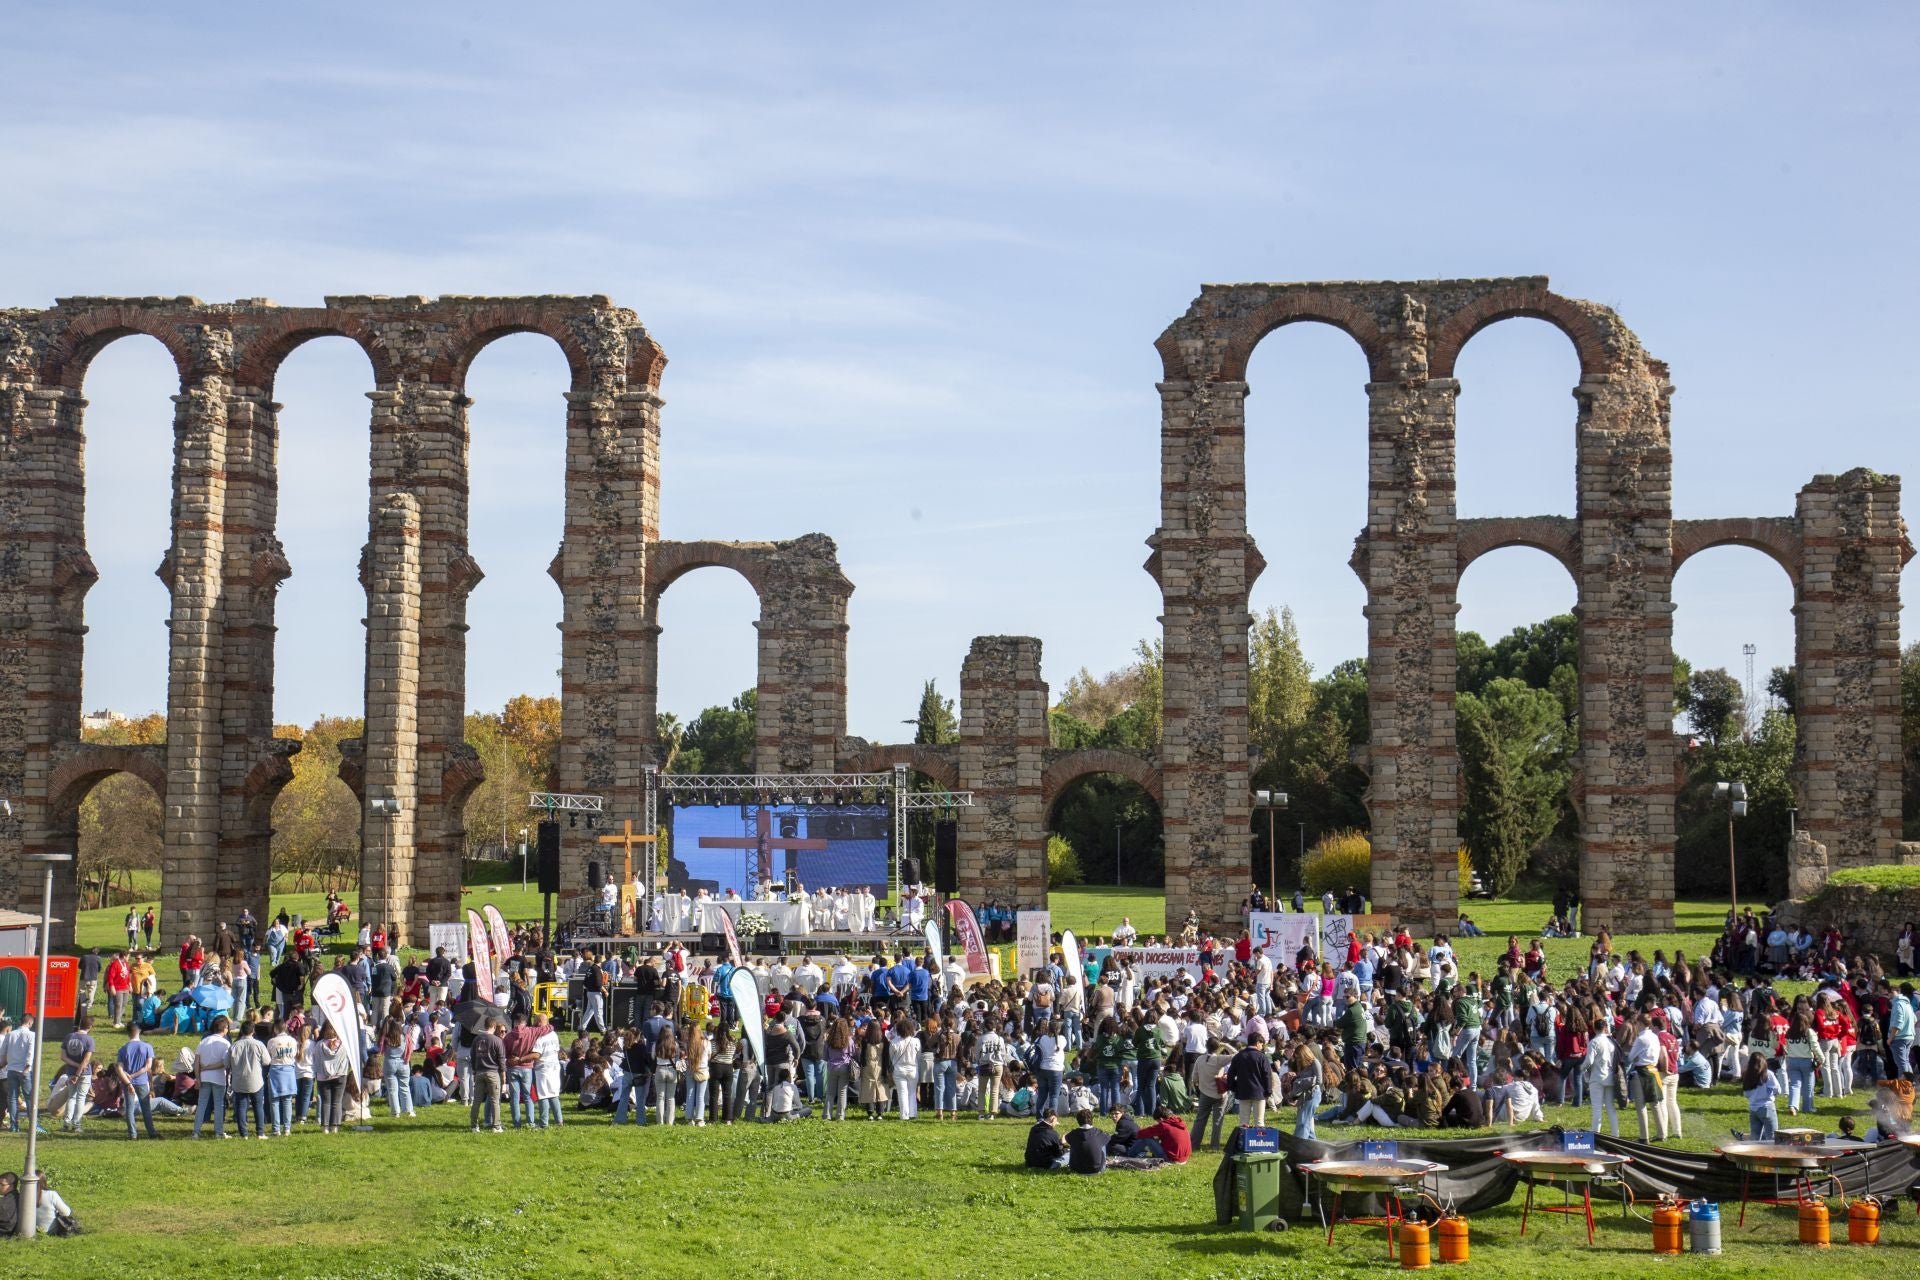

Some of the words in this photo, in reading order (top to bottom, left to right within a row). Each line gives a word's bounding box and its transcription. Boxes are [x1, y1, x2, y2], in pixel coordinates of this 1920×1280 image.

[1146, 952, 1185, 966] DIOCESANA
[1186, 953, 1196, 964] DE
[1248, 1139, 1275, 1147] Mahou
